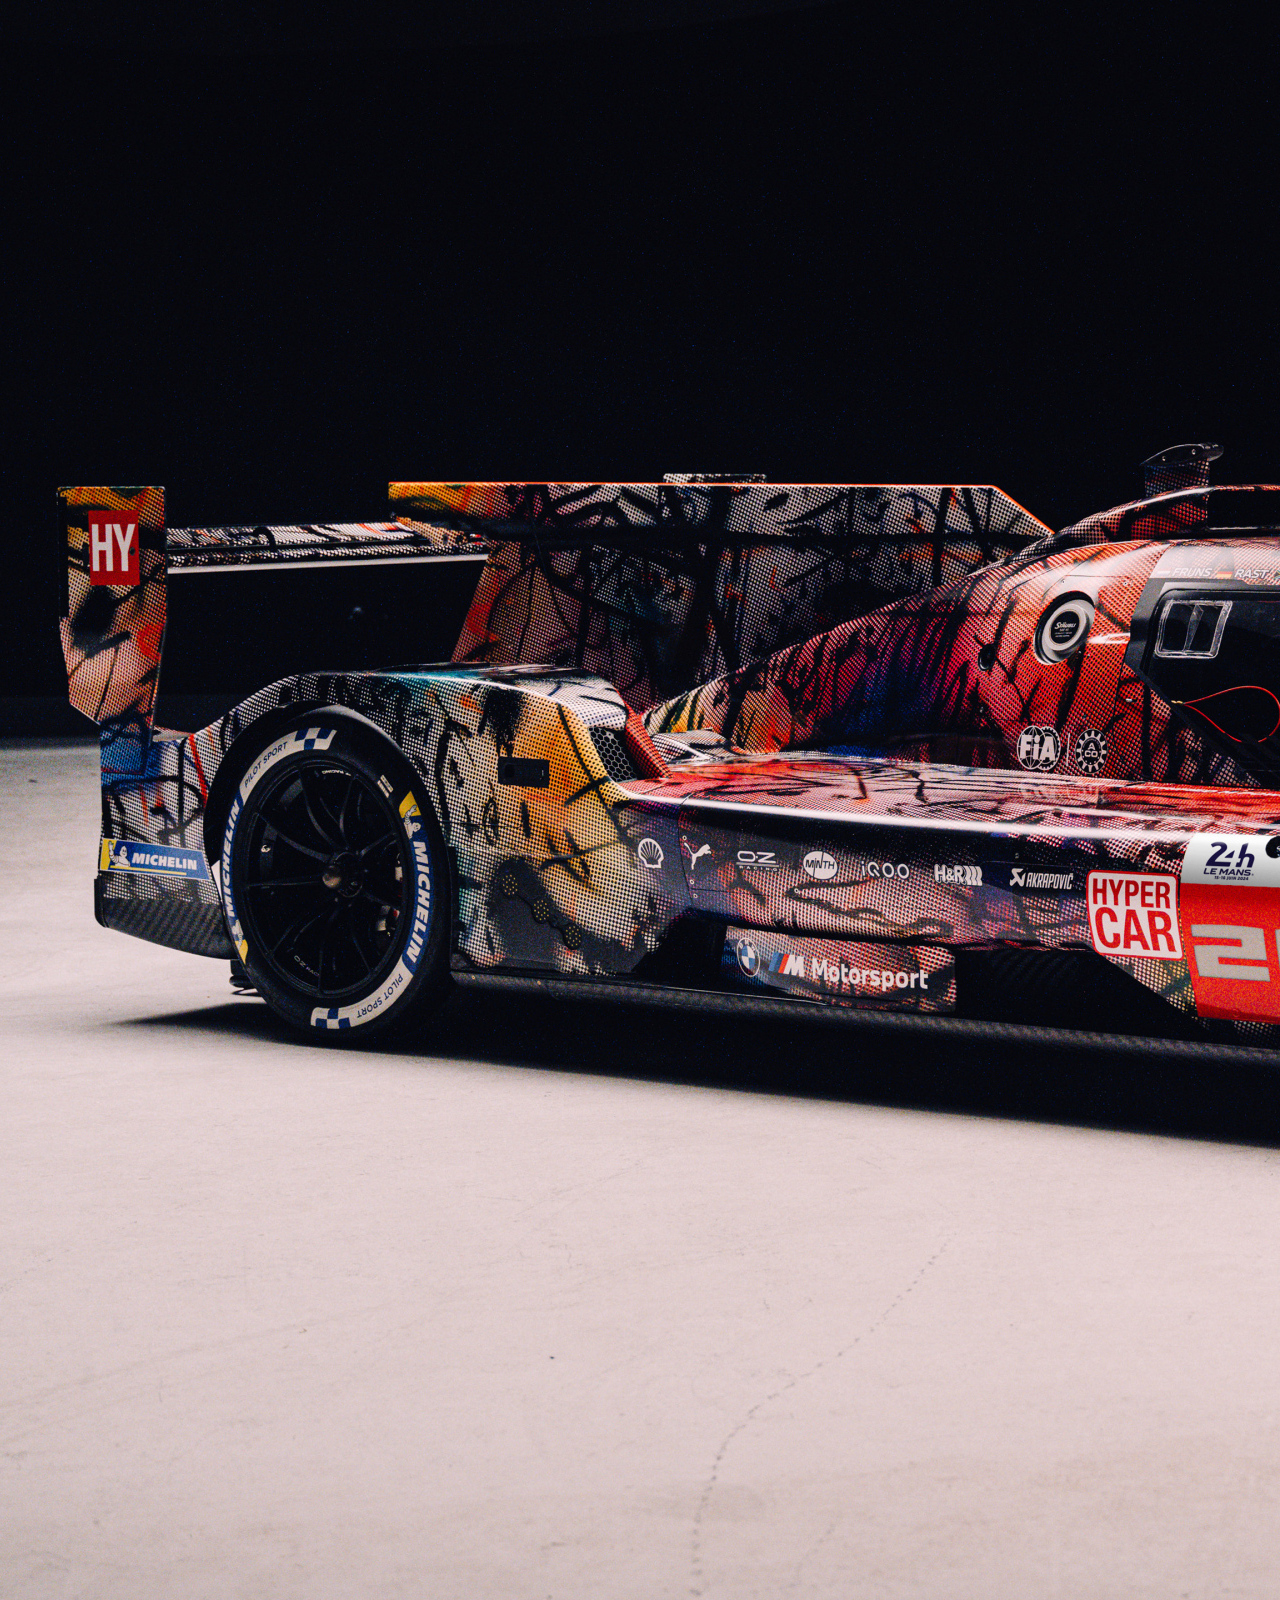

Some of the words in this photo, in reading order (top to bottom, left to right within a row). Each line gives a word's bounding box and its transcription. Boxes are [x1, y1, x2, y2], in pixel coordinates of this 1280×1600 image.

[92, 523, 136, 572] HY
[1234, 568, 1270, 579] RAST
[244, 760, 262, 788] PILOT
[263, 741, 288, 764] SPORT
[132, 852, 198, 870] MICHELIN
[222, 799, 240, 918] MICHELIN
[1205, 841, 1255, 868] 24h
[861, 860, 910, 879] iQOO
[1203, 867, 1218, 875] LE
[406, 840, 432, 964] MICHELIN
[1092, 878, 1171, 909] HYPER
[1095, 906, 1178, 952] CAR
[384, 973, 404, 1001] PILOT
[811, 957, 929, 992] Motorsport
[356, 996, 383, 1019] SPORT
